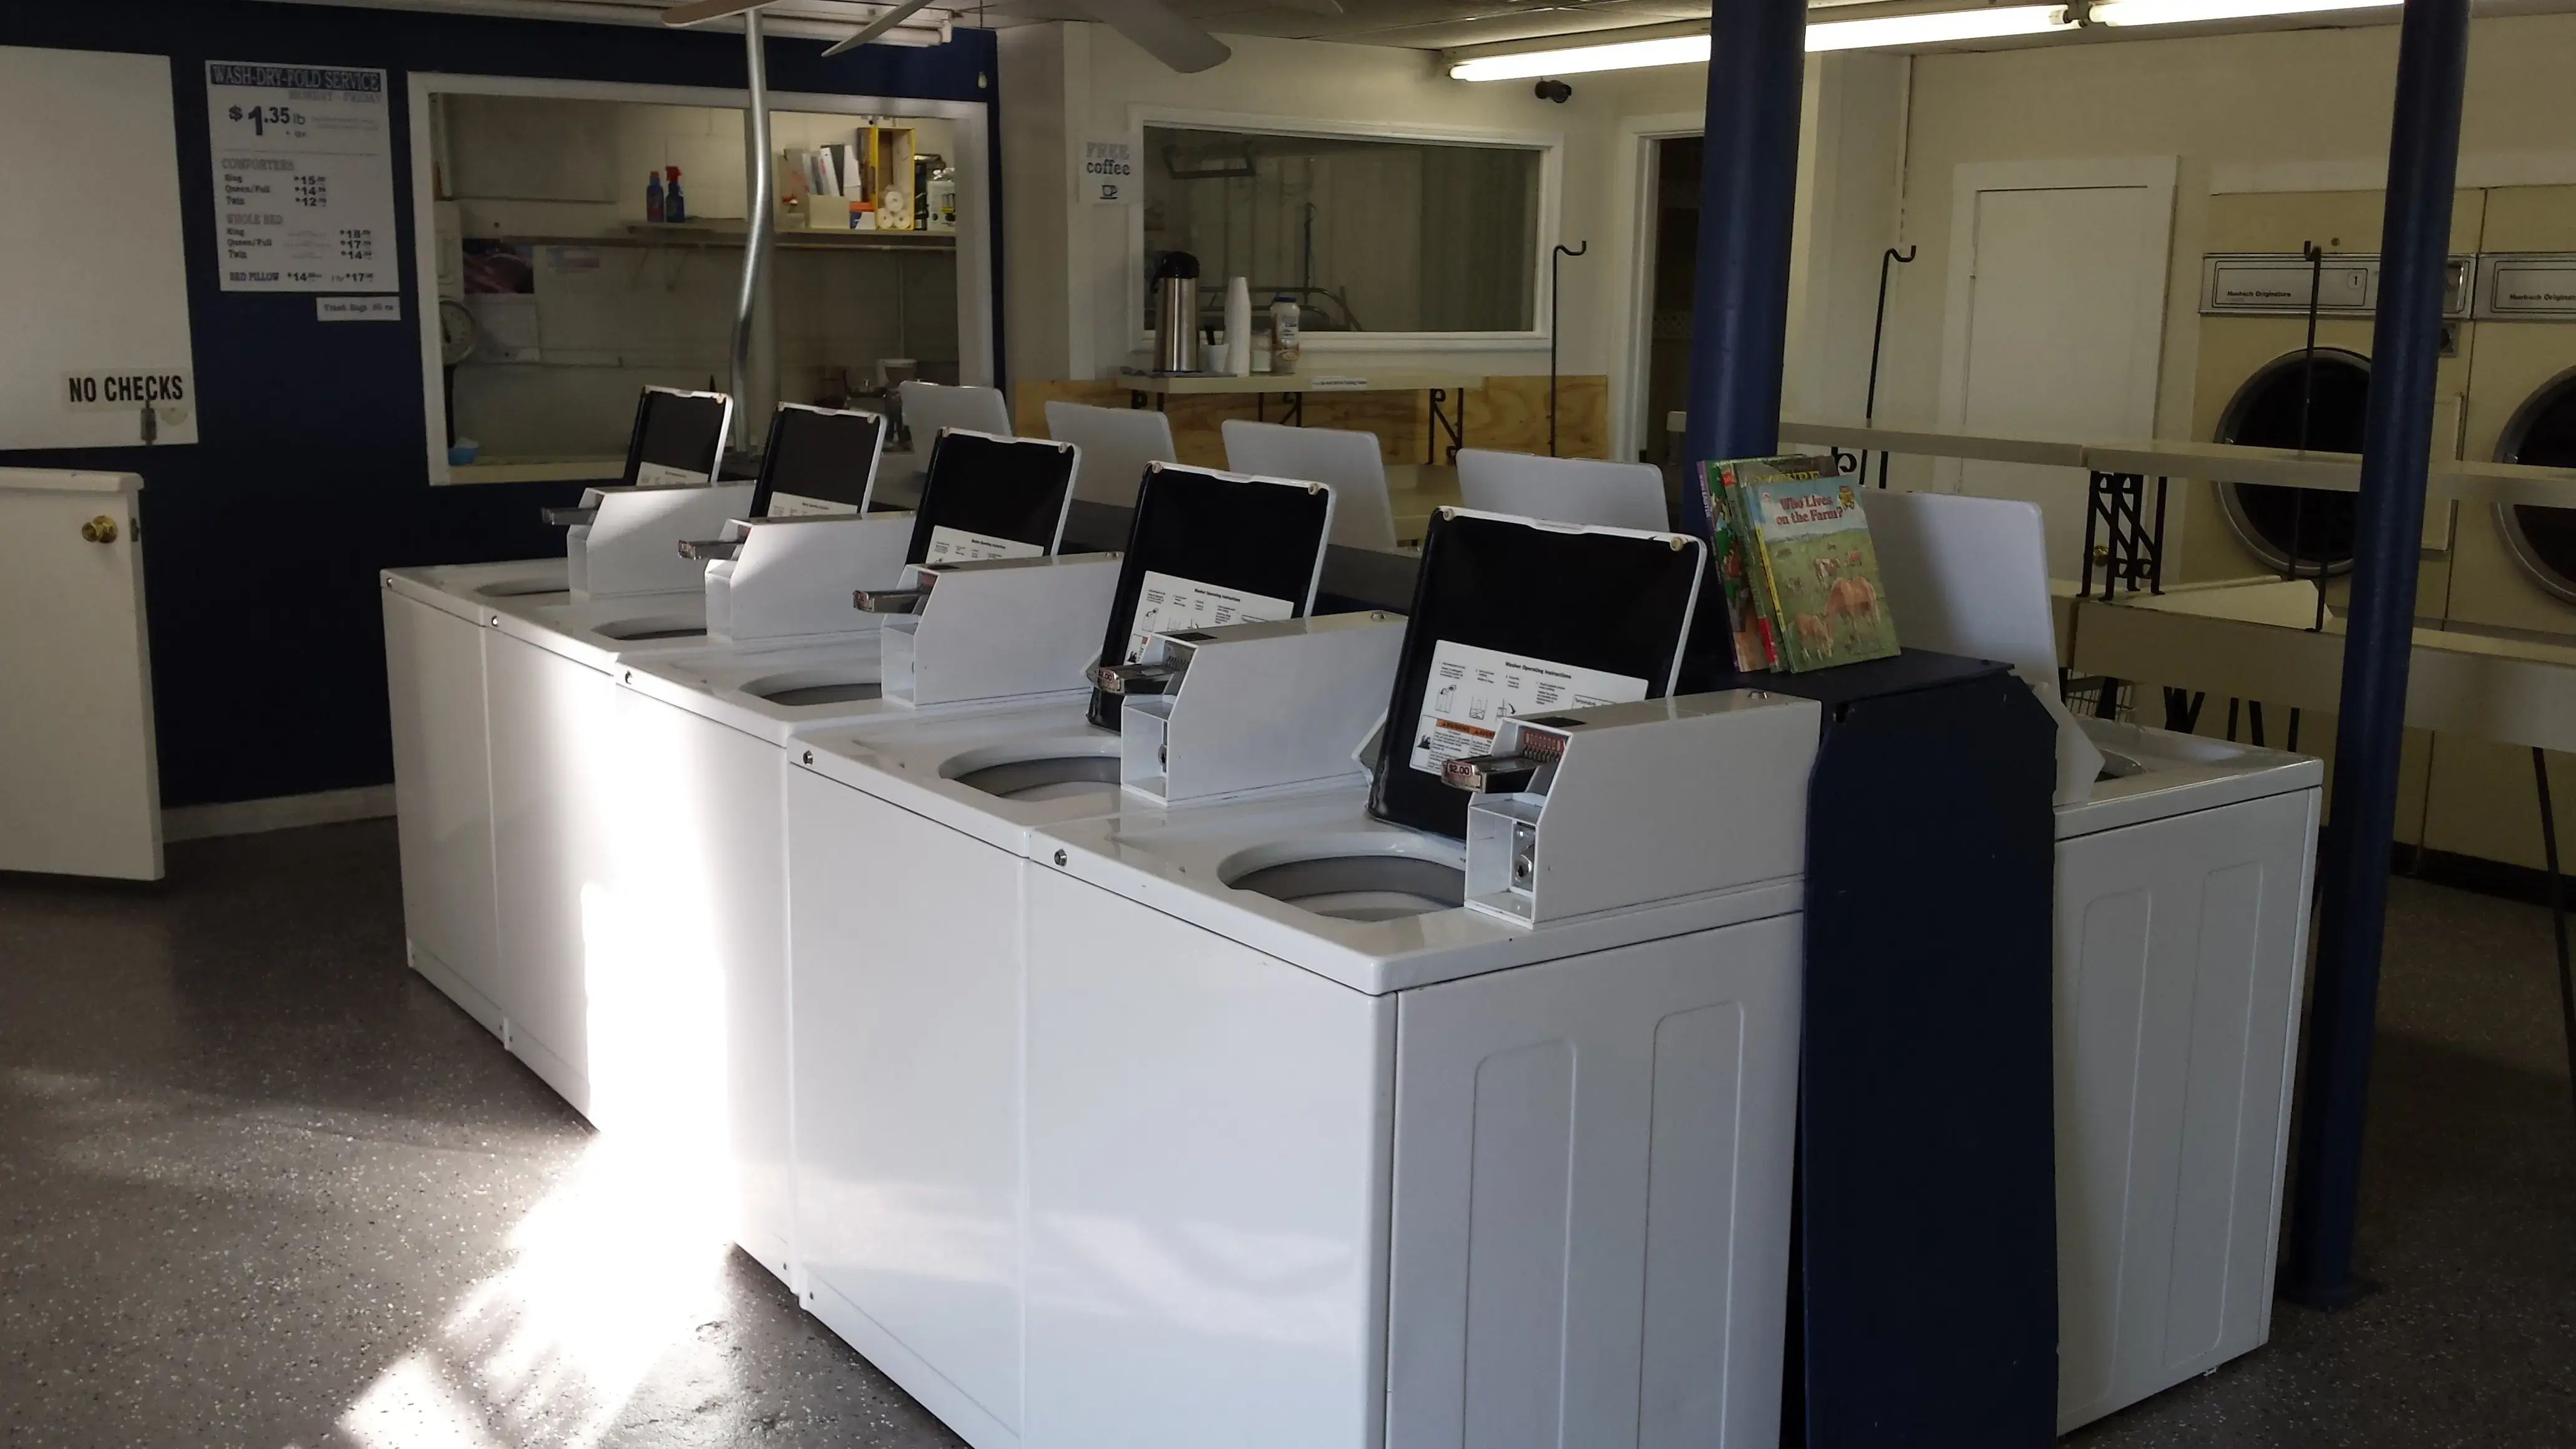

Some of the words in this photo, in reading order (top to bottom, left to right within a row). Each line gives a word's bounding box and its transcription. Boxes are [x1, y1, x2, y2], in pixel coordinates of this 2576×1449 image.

[213, 66, 321, 88] WASH-DRY-FOLD
[324, 72, 379, 90] SERVICE
[293, 114, 305, 125] lb
[1086, 142, 1129, 160] FREE
[1086, 159, 1130, 175] coffee
[2353, 275, 2358, 285] 1
[69, 377, 96, 402] NO
[104, 375, 183, 402] CHECKS
[1780, 497, 1803, 510] Who
[1804, 494, 1833, 507] Lives
[1776, 514, 1790, 525] on
[1791, 510, 1808, 524] the
[1810, 506, 1843, 521] Farm?
[1522, 665, 1544, 675] Operating
[1544, 668, 1571, 679] Instructions
[1449, 764, 1470, 776] $2.00
